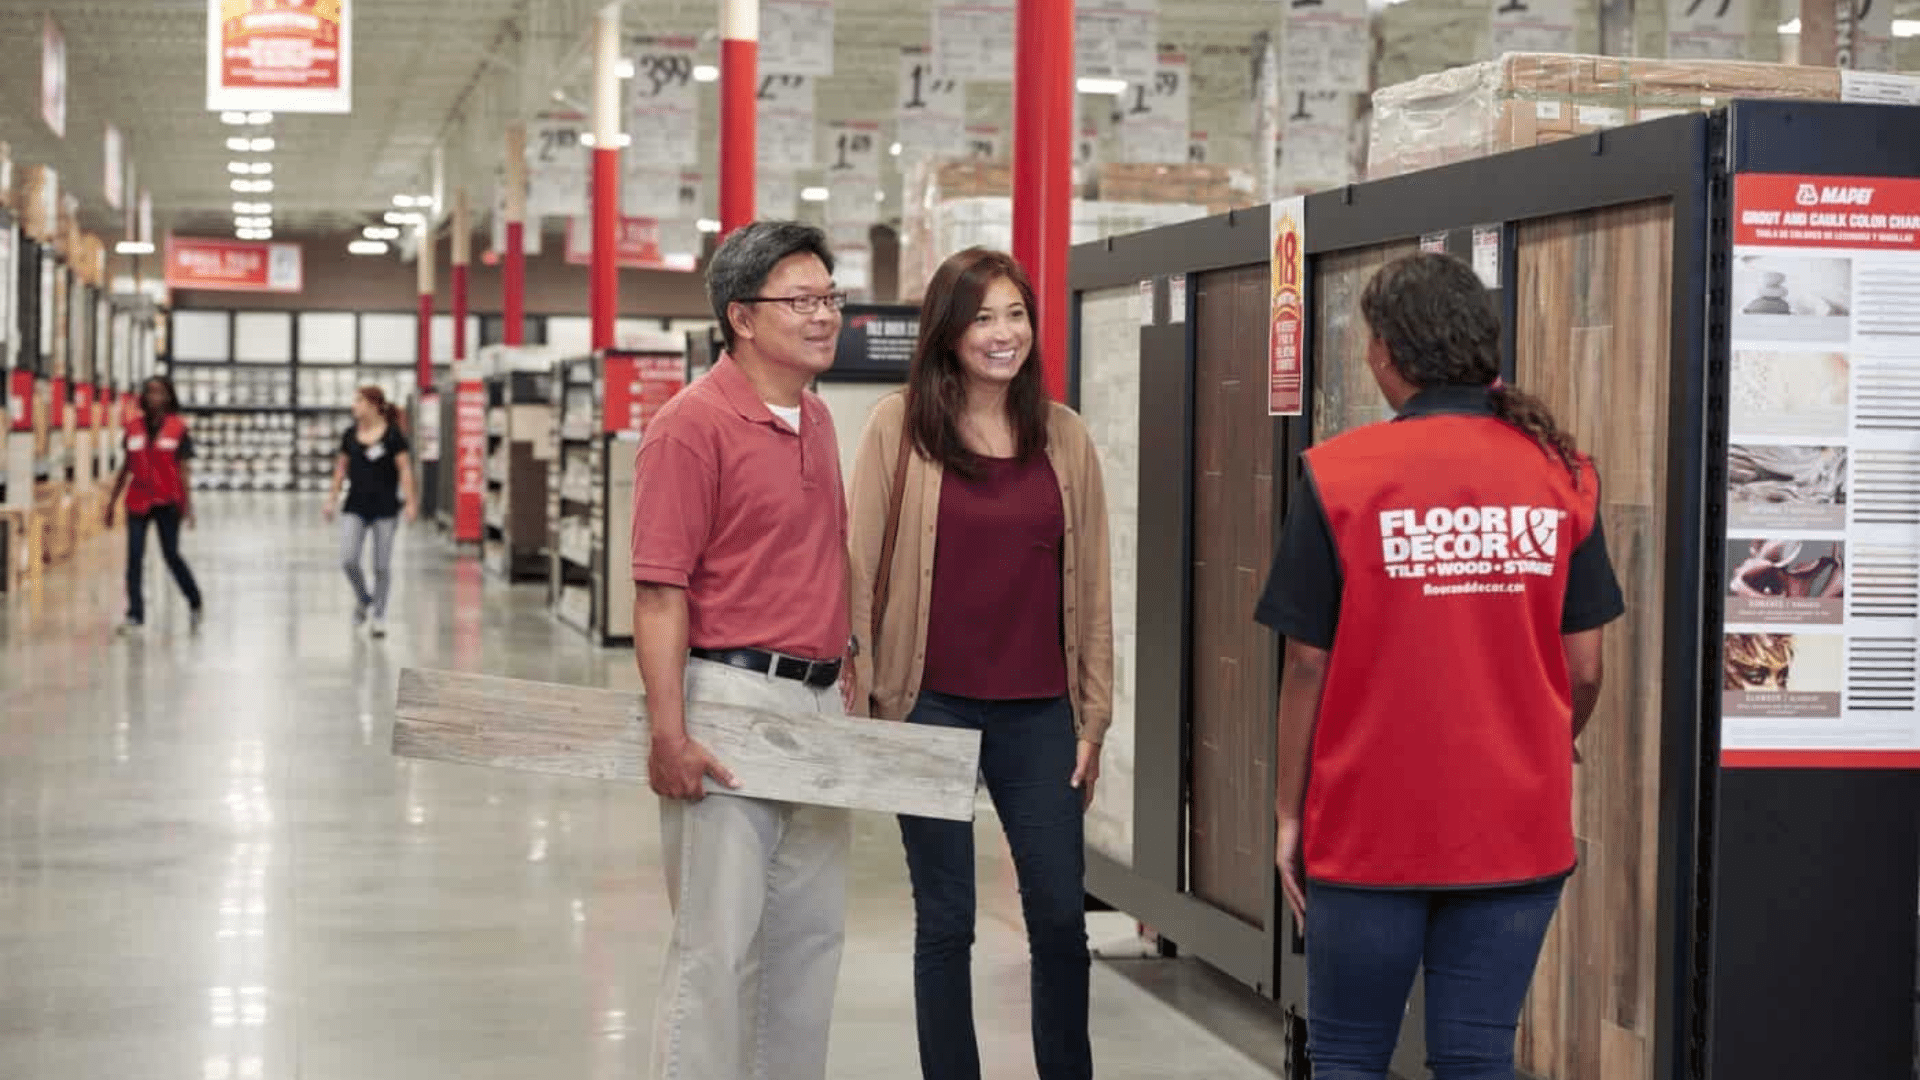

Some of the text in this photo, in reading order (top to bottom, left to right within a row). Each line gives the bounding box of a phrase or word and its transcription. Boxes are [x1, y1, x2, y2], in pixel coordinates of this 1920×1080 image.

[1820, 186, 1876, 205] MAPEI
[1742, 210, 1781, 226] GROUT
[1783, 211, 1807, 227] AND
[1810, 212, 1847, 228] CAULK
[1849, 213, 1887, 229] COLOR
[1380, 506, 1509, 536] FLOOR
[1382, 533, 1510, 563] DECOR
[1385, 562, 1427, 579] TILE
[1436, 561, 1493, 577] WOOD
